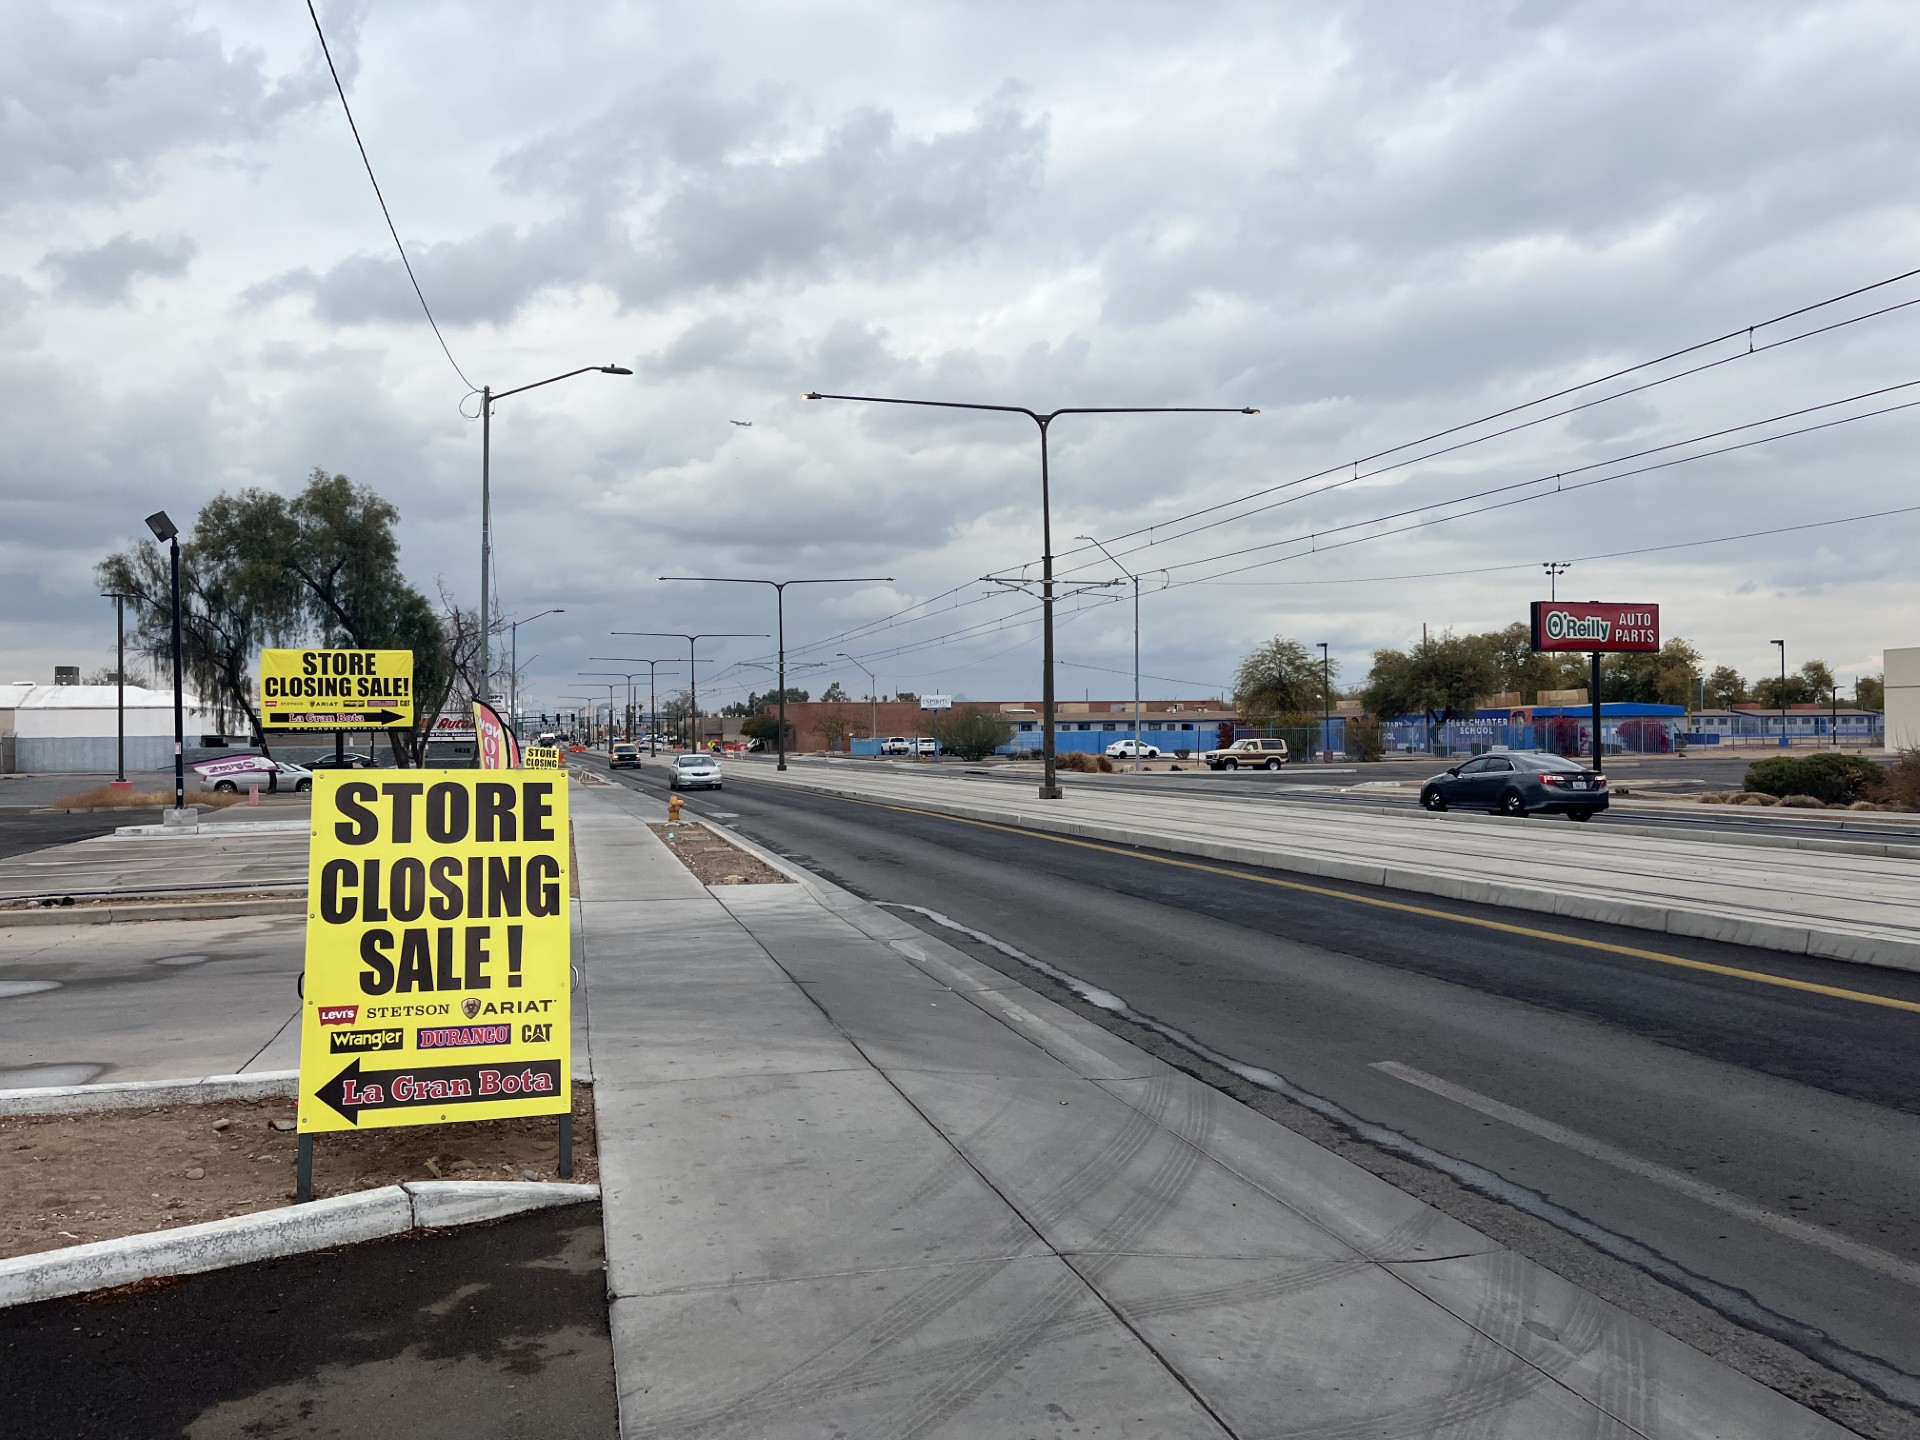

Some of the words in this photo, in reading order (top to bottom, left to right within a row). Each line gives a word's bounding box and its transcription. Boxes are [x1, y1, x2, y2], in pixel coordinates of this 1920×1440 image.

[1546, 611, 1611, 642] O'Reilly
[1619, 613, 1651, 626] AUTO
[1615, 629, 1655, 643] PARTS
[302, 652, 376, 676] STORE
[265, 677, 352, 697] CLOSING
[357, 677, 409, 697] SALE!
[289, 713, 304, 723] La
[305, 713, 335, 723] Gran
[337, 713, 364, 723] Bota
[1468, 718, 1508, 726] CHARTER
[1459, 727, 1494, 735] SCHOOL
[528, 748, 557, 758] STORE
[526, 758, 557, 768] CLOSING
[334, 781, 555, 845] STORE
[320, 854, 561, 924] CLOSING
[366, 1004, 450, 1019] STETSON
[482, 1000, 553, 1016] ARIAT
[332, 1030, 402, 1051] Wrangler
[420, 1026, 508, 1049] DURANGO
[521, 1023, 553, 1043] CAT
[342, 1080, 384, 1107] La
[391, 1074, 472, 1102] Gran
[478, 1068, 554, 1095] Bota
